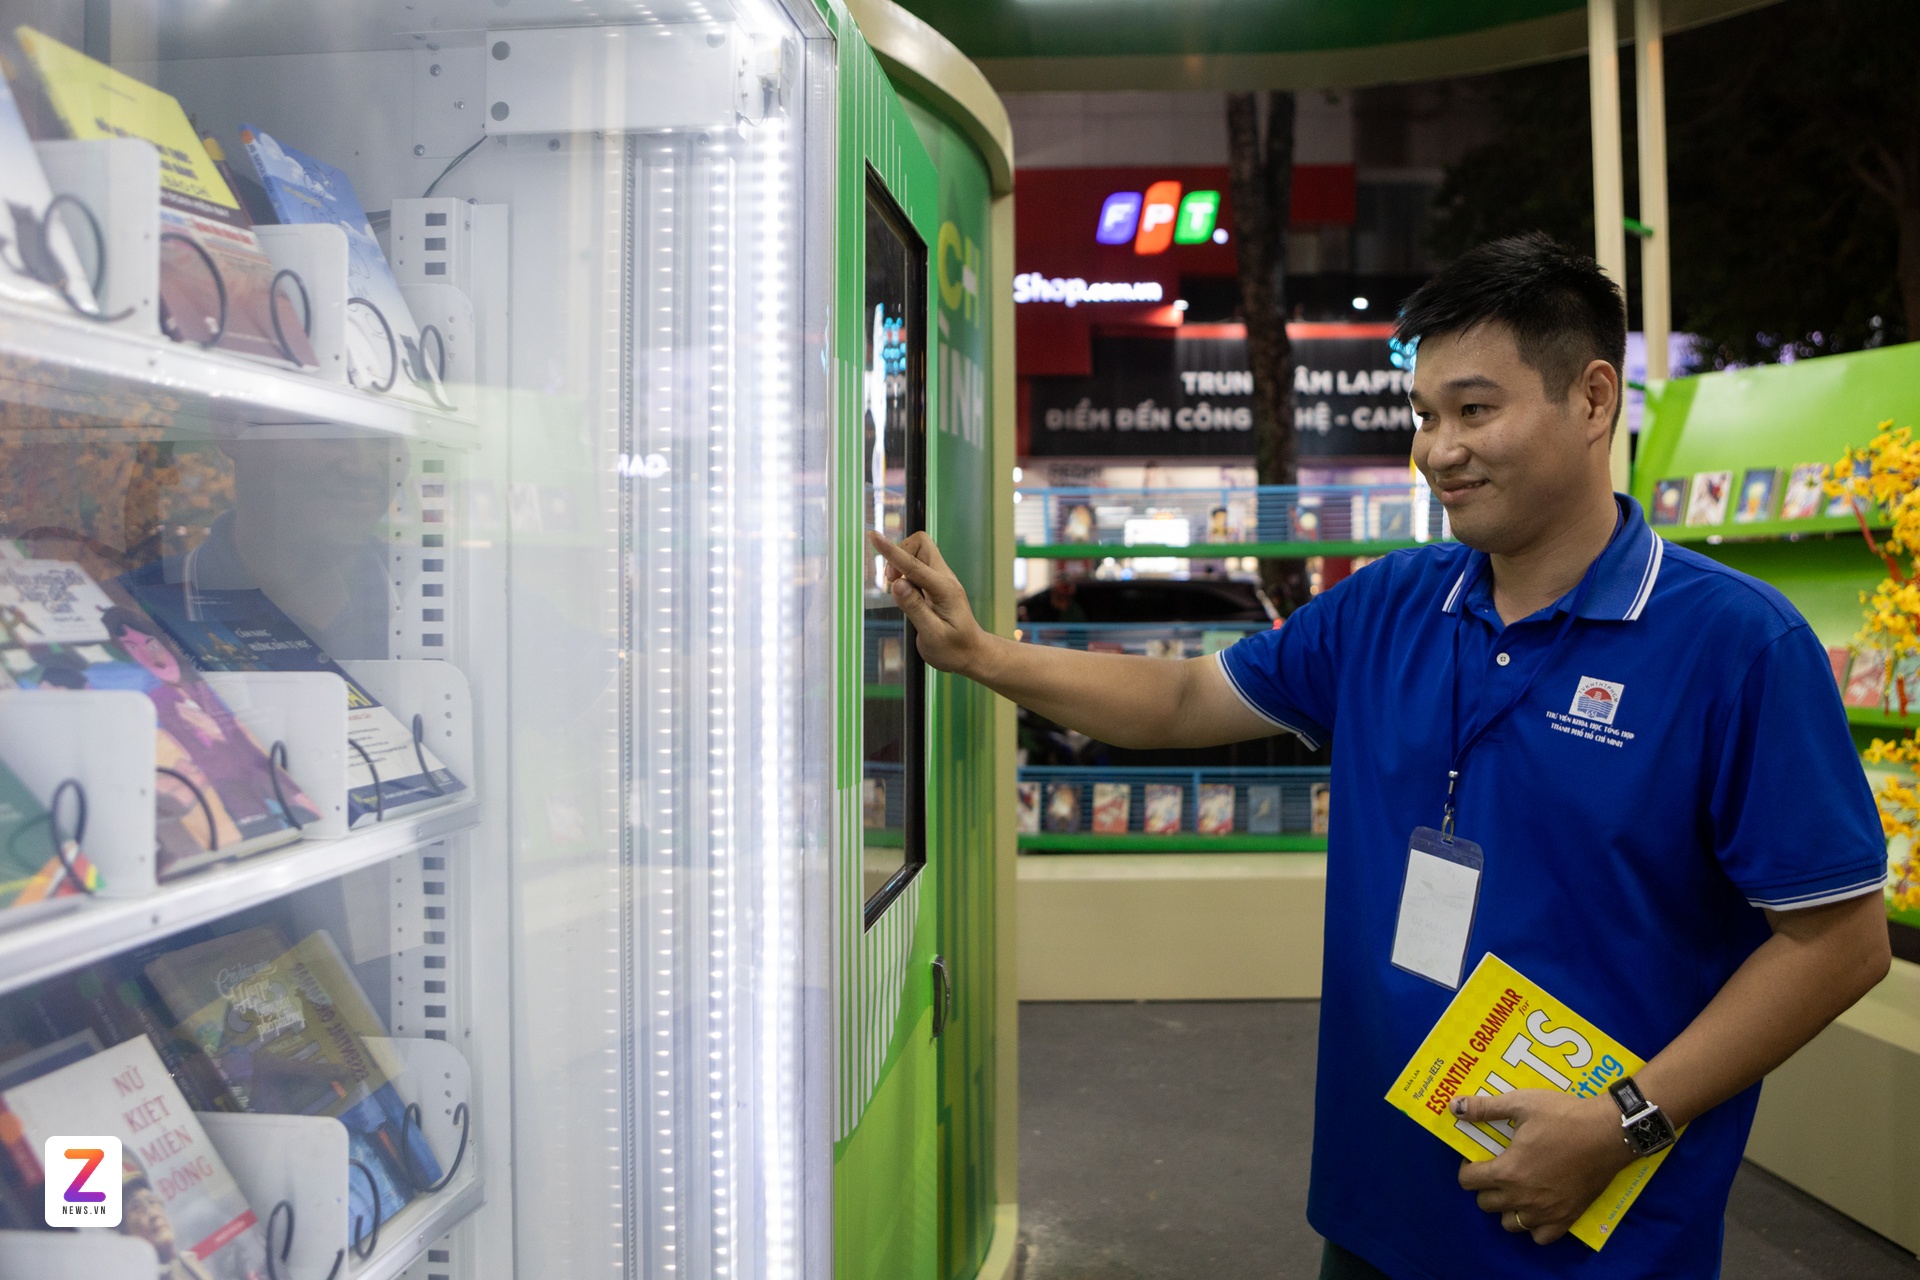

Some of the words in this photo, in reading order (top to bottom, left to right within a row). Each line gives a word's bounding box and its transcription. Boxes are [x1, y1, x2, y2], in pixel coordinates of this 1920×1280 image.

[1181, 370, 1254, 395] TRUN
[1294, 365, 1333, 395] ÂM
[1337, 369, 1413, 395] LAPTO
[1175, 401, 1253, 431] CÔNG
[1294, 401, 1332, 437] HỆ
[1351, 405, 1412, 431] CAM
[1518, 1000, 1530, 1016] for
[1426, 1051, 1479, 1116] ESSENTIAL
[1469, 987, 1523, 1054] GRAMMAR
[1429, 1057, 1445, 1076] IELTS
[1412, 1069, 1421, 1080] LAN
[1454, 1009, 1593, 1157] ITS
[1571, 1054, 1624, 1099] iting
